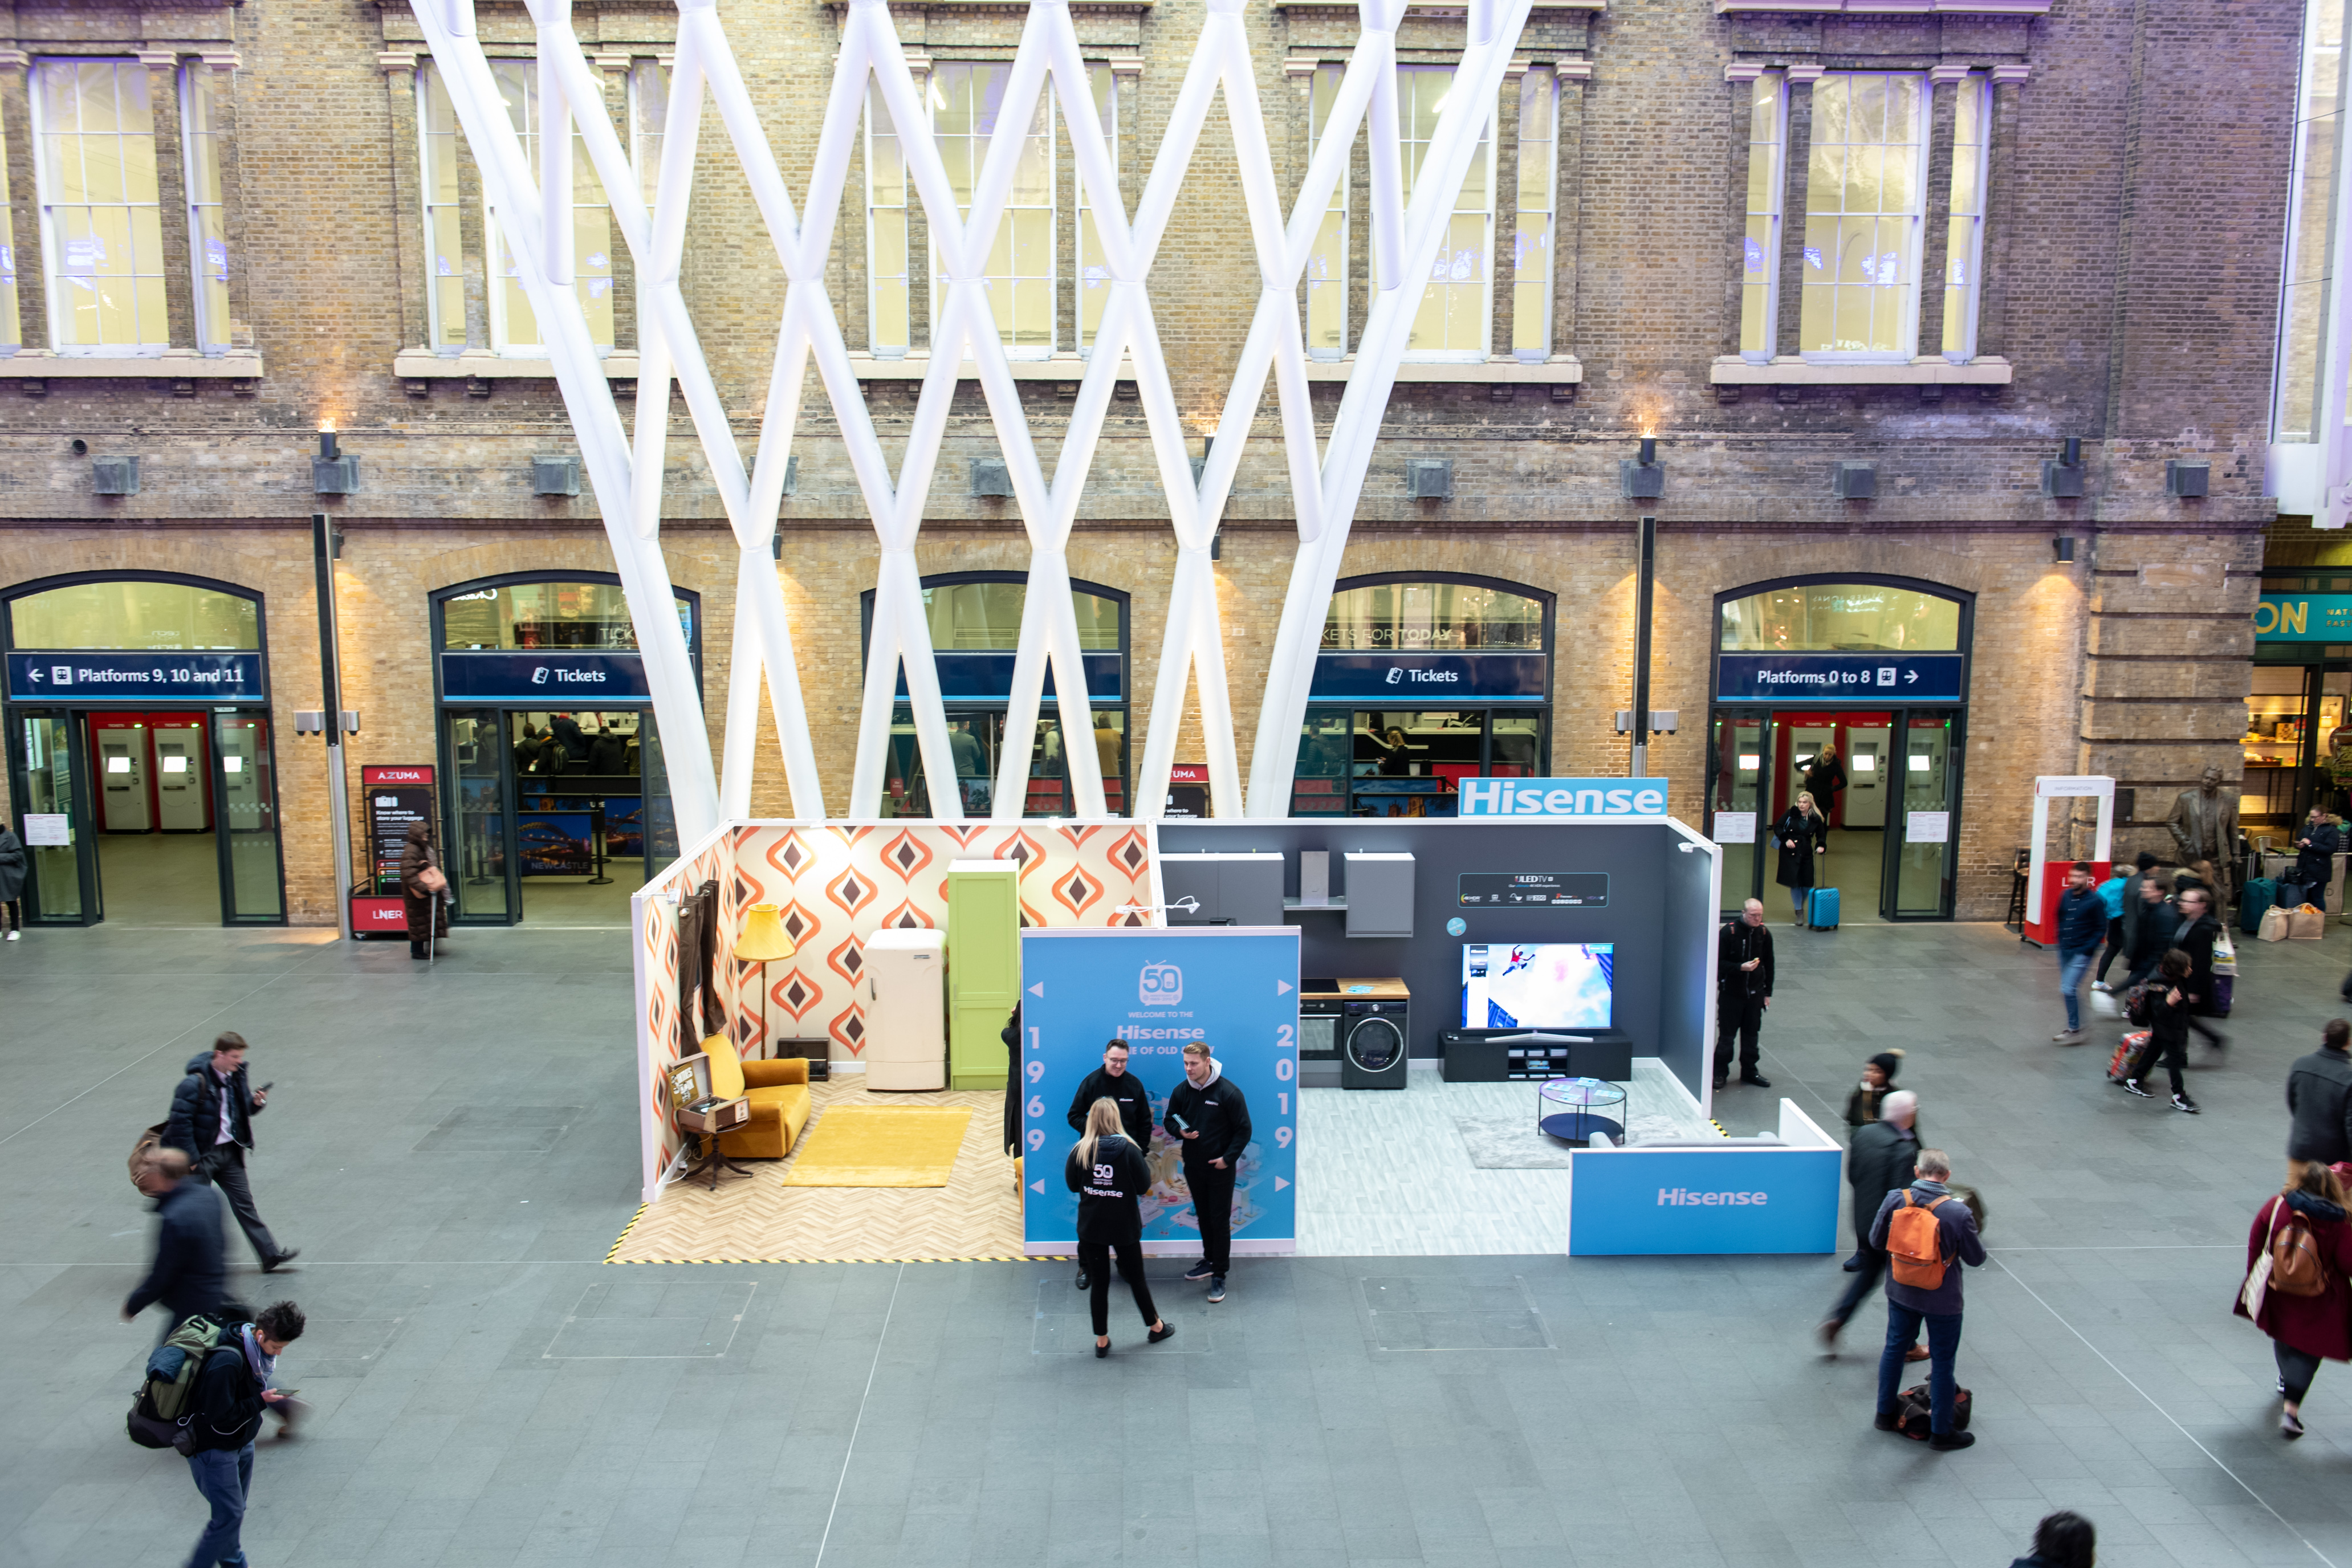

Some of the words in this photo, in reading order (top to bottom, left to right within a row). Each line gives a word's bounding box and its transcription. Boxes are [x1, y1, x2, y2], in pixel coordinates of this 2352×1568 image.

[2251, 602, 2308, 633] ON
[600, 628, 633, 640] TICK
[1321, 629, 1357, 641] KETS
[1362, 629, 1393, 641] FOR
[1398, 629, 1452, 641] TODAY
[79, 669, 149, 682] Platforms
[152, 669, 166, 684] 9,
[171, 669, 190, 682] 10
[193, 669, 221, 682] and
[225, 669, 244, 682] 11
[554, 669, 607, 682] Tickets
[1408, 669, 1458, 682] Tickets
[1757, 670, 1826, 683] Platforms
[1829, 670, 1839, 683] 0
[1841, 671, 1858, 683] to
[1860, 670, 1870, 683] 8
[378, 771, 420, 780] AZUMA
[1463, 781, 1663, 814] Hisense
[2061, 877, 2096, 886] LR
[372, 909, 403, 920] LNER
[1116, 1025, 1205, 1040] Hisense
[1083, 1186, 1123, 1198] Hisense
[1657, 1188, 1767, 1206] Hisense
